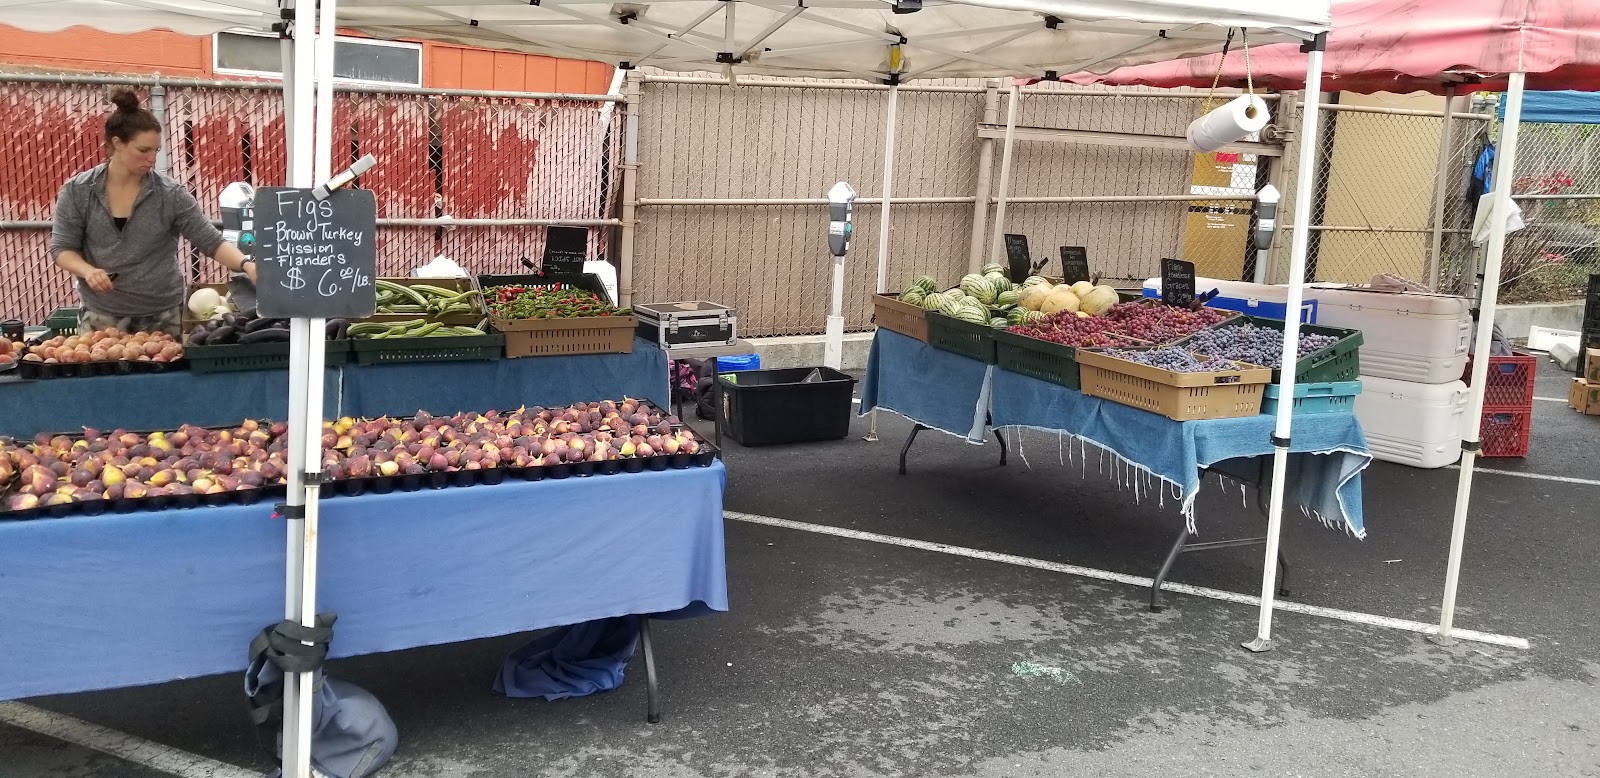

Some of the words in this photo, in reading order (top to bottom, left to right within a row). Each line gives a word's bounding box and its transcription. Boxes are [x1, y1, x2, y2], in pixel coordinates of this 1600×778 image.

[276, 190, 333, 232] Figs
[276, 221, 314, 242] Brown
[318, 222, 363, 246] Turkey
[277, 242, 333, 255] Mission
[277, 253, 346, 267] Flanders
[280, 267, 306, 291] $
[1165, 277, 1190, 292] Grapes
